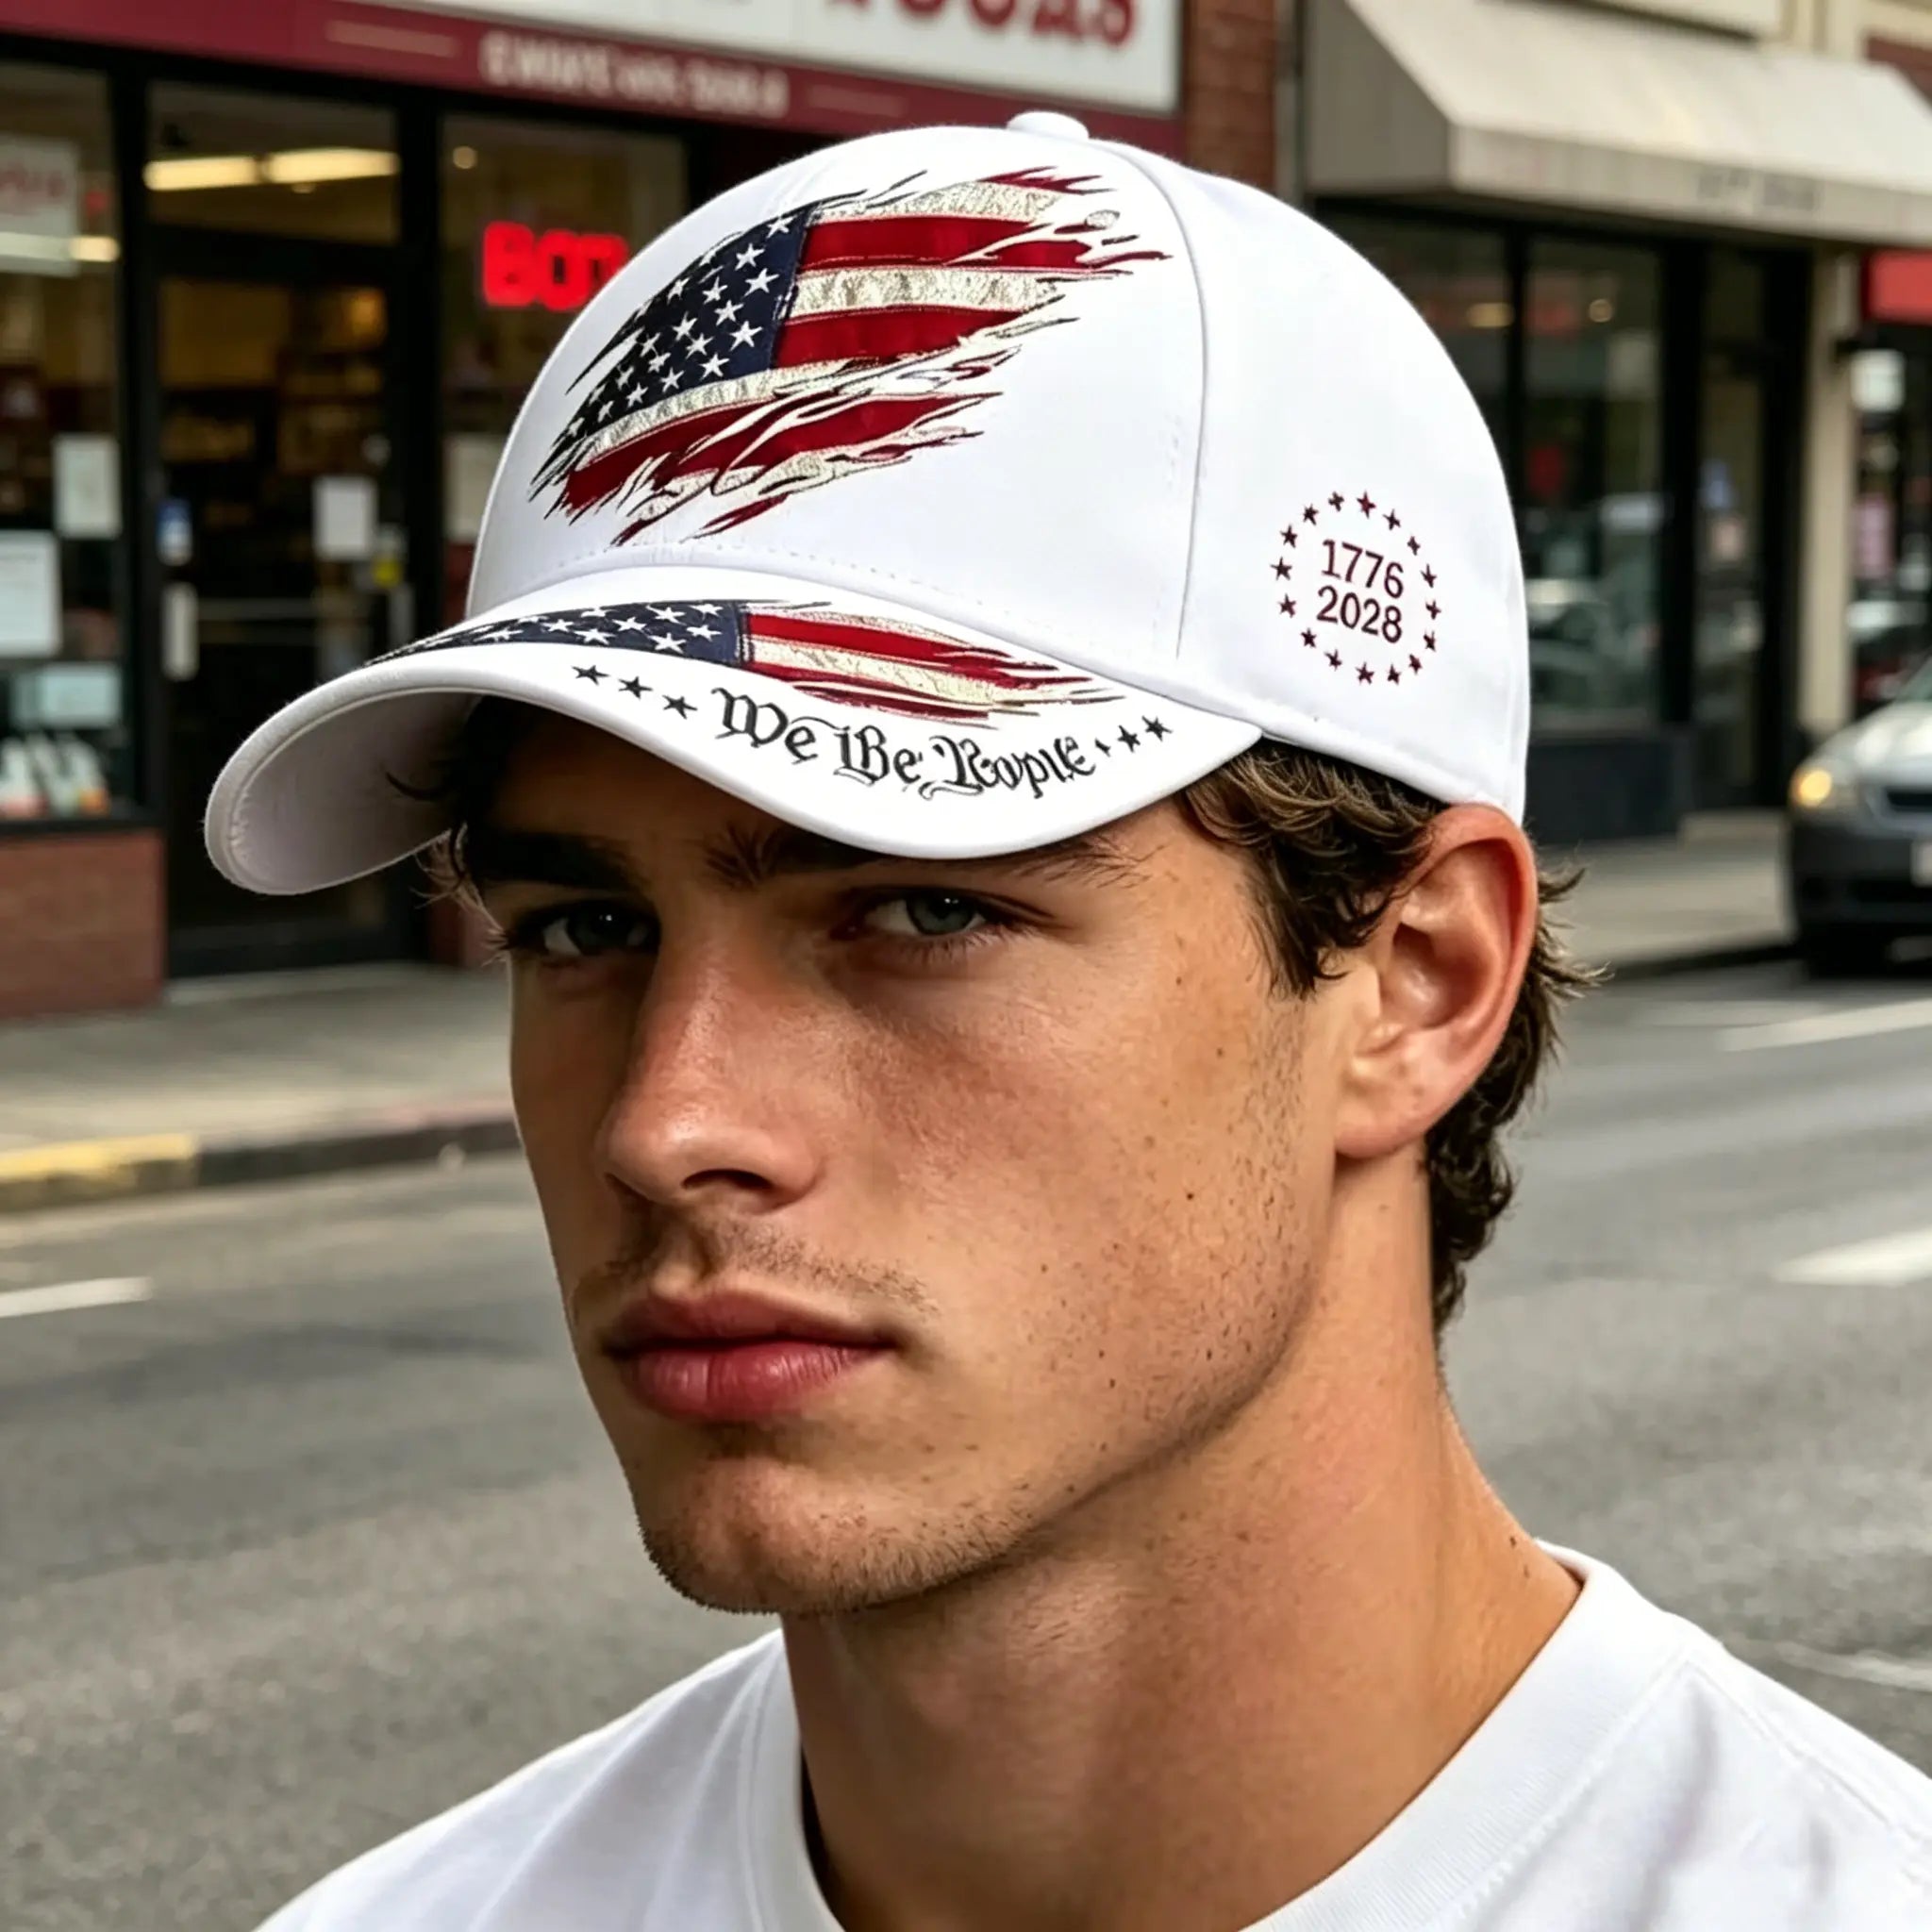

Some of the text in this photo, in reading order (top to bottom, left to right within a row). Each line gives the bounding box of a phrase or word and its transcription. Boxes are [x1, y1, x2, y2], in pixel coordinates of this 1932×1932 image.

[1322, 539, 1404, 599] 1776
[1316, 585, 1403, 643] 2028
[711, 688, 818, 765] We
